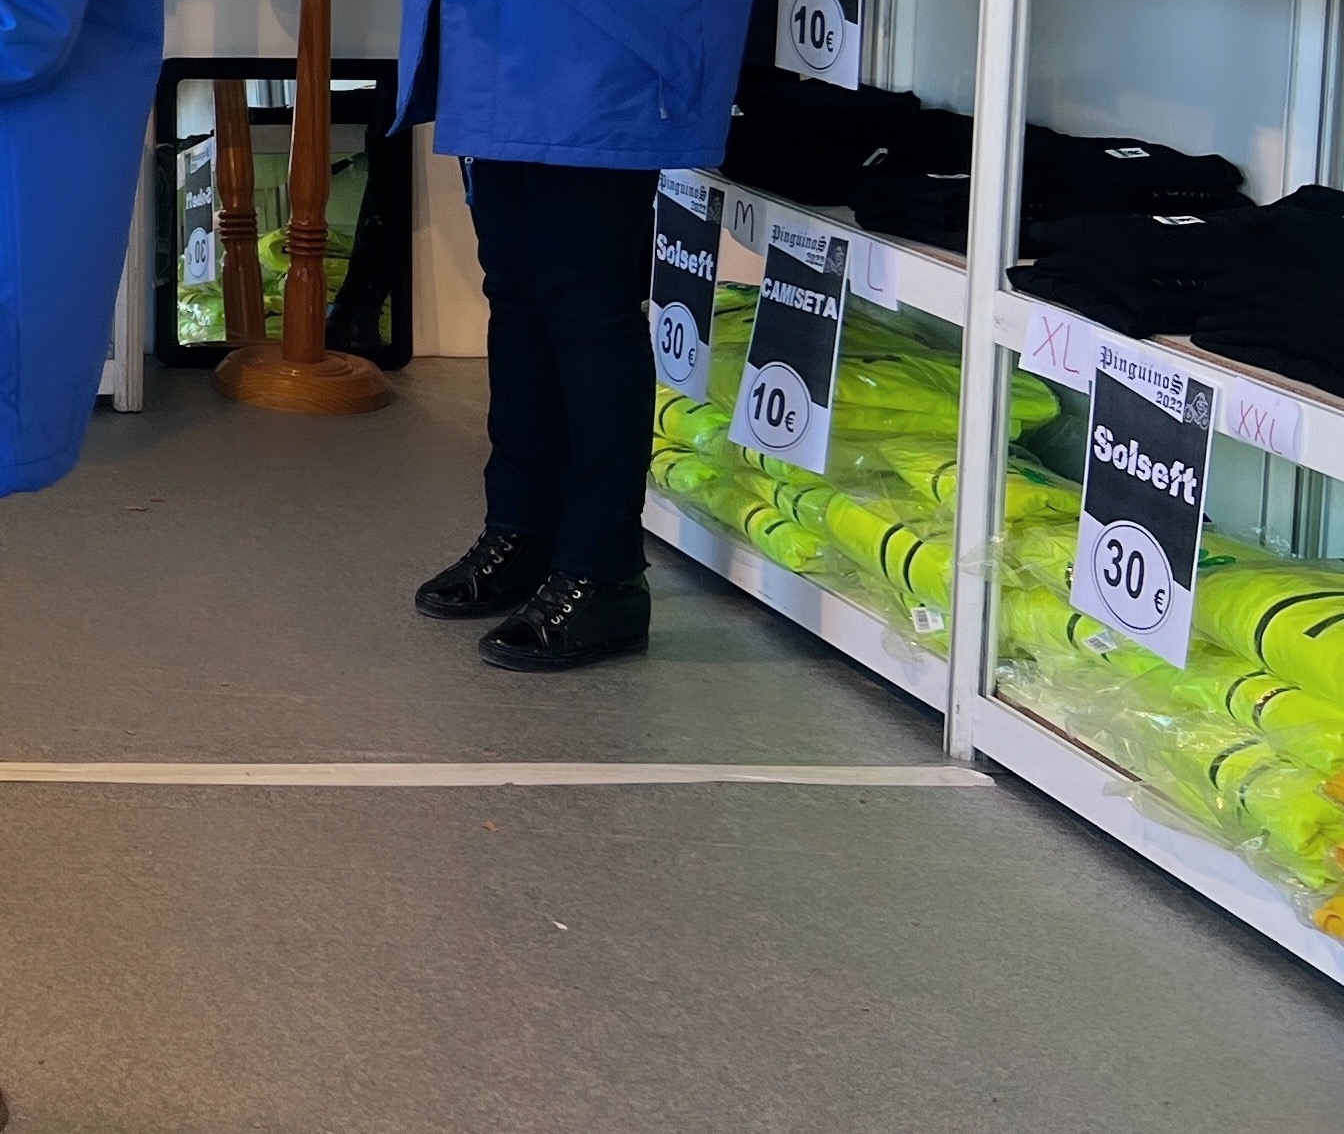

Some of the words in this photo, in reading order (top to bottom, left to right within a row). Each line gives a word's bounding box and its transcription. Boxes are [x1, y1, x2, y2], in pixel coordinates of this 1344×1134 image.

[794, 5, 834, 52] 10€
[734, 200, 755, 243] M
[656, 233, 714, 282] Solseft
[867, 242, 885, 293] L
[761, 277, 838, 320] CAMISETA
[661, 317, 685, 360] 30
[1032, 316, 1079, 375] XL
[752, 382, 796, 433] 10€
[1155, 390, 1184, 415] 2022
[1236, 400, 1283, 456] XXL
[1093, 424, 1198, 506] Solseft
[1103, 538, 1145, 599] 30
